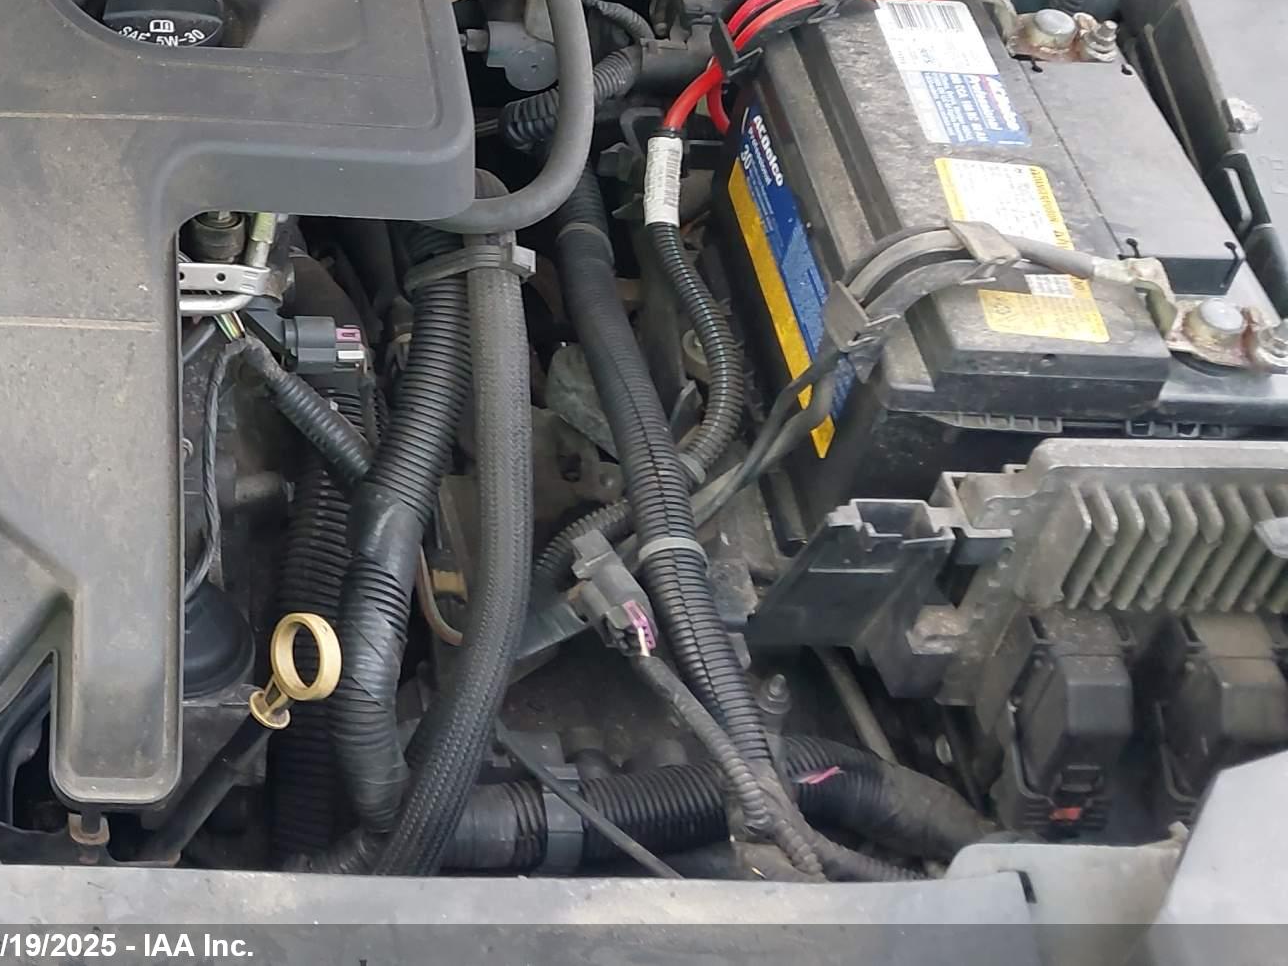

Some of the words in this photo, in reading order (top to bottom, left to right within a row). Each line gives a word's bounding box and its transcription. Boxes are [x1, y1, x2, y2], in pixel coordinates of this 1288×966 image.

[118, 26, 150, 42] SAE
[156, 29, 205, 47] 5W-30
[753, 115, 784, 187] ACDelco
